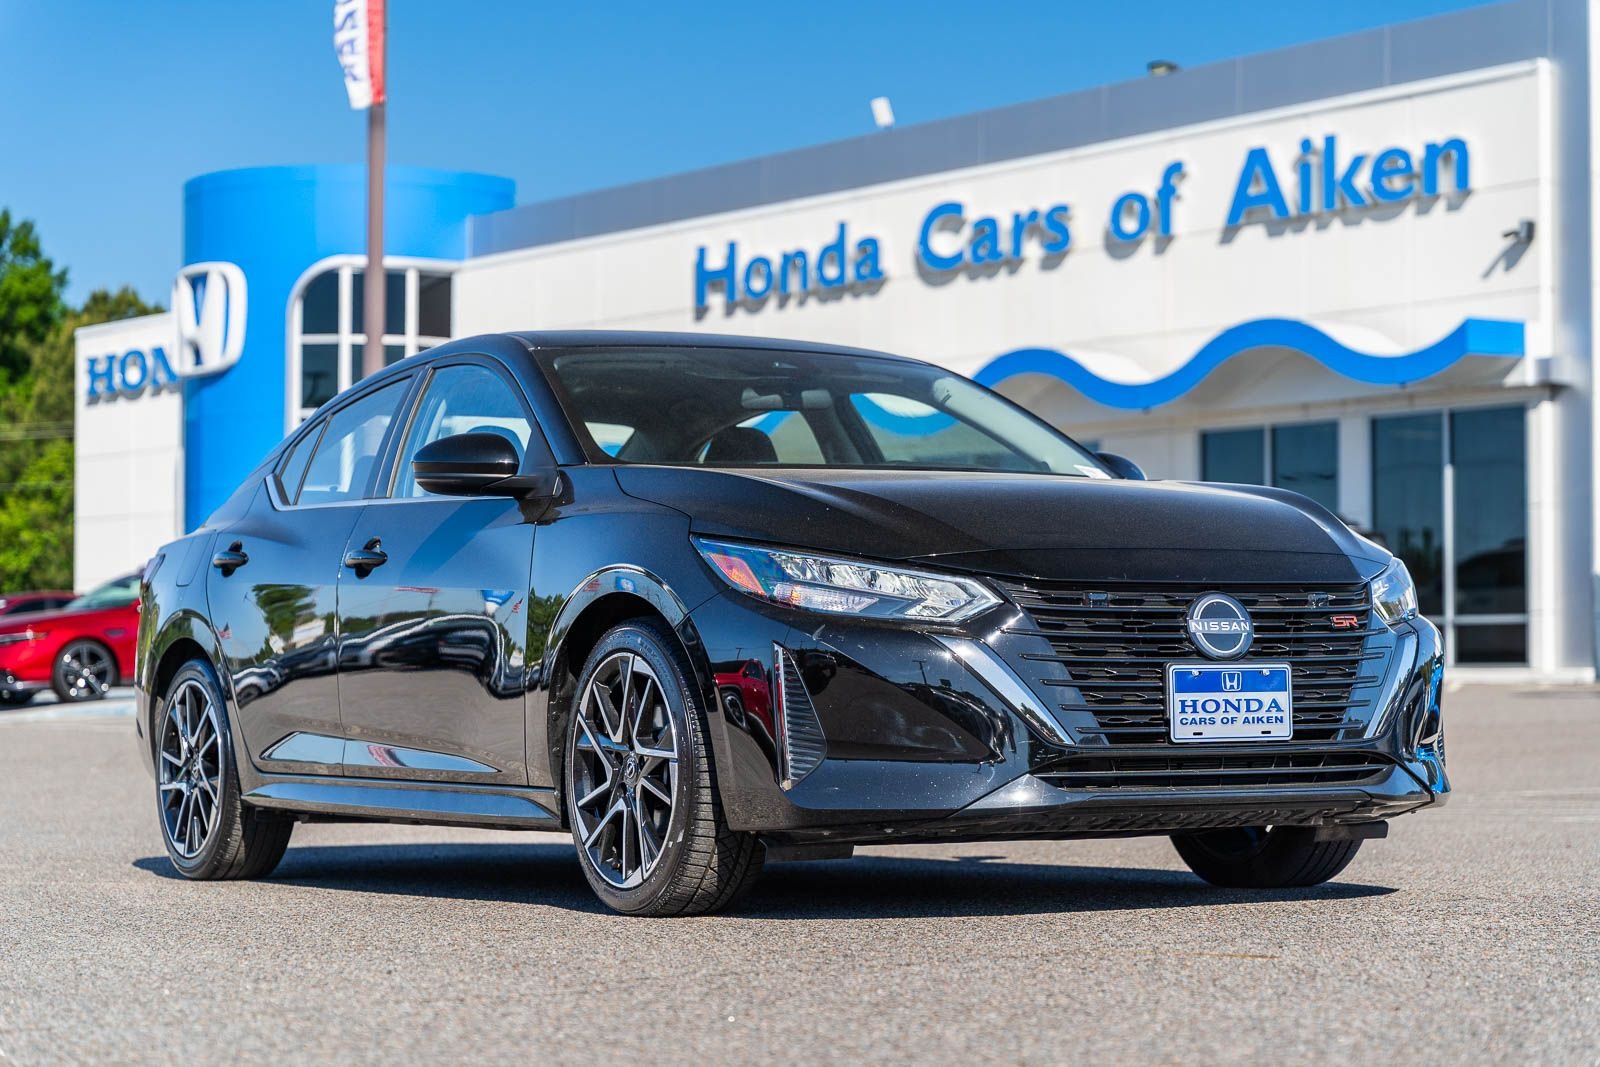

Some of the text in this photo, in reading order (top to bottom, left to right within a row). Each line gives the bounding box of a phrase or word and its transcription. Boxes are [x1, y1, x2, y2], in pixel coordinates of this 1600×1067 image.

[695, 134, 1470, 308] Honda Cars of Aiken
[1190, 621, 1250, 632] NISSAN
[1331, 615, 1359, 628] SR
[1178, 698, 1284, 714] HONDA
[1179, 715, 1284, 726] CARS OF AIKEN
